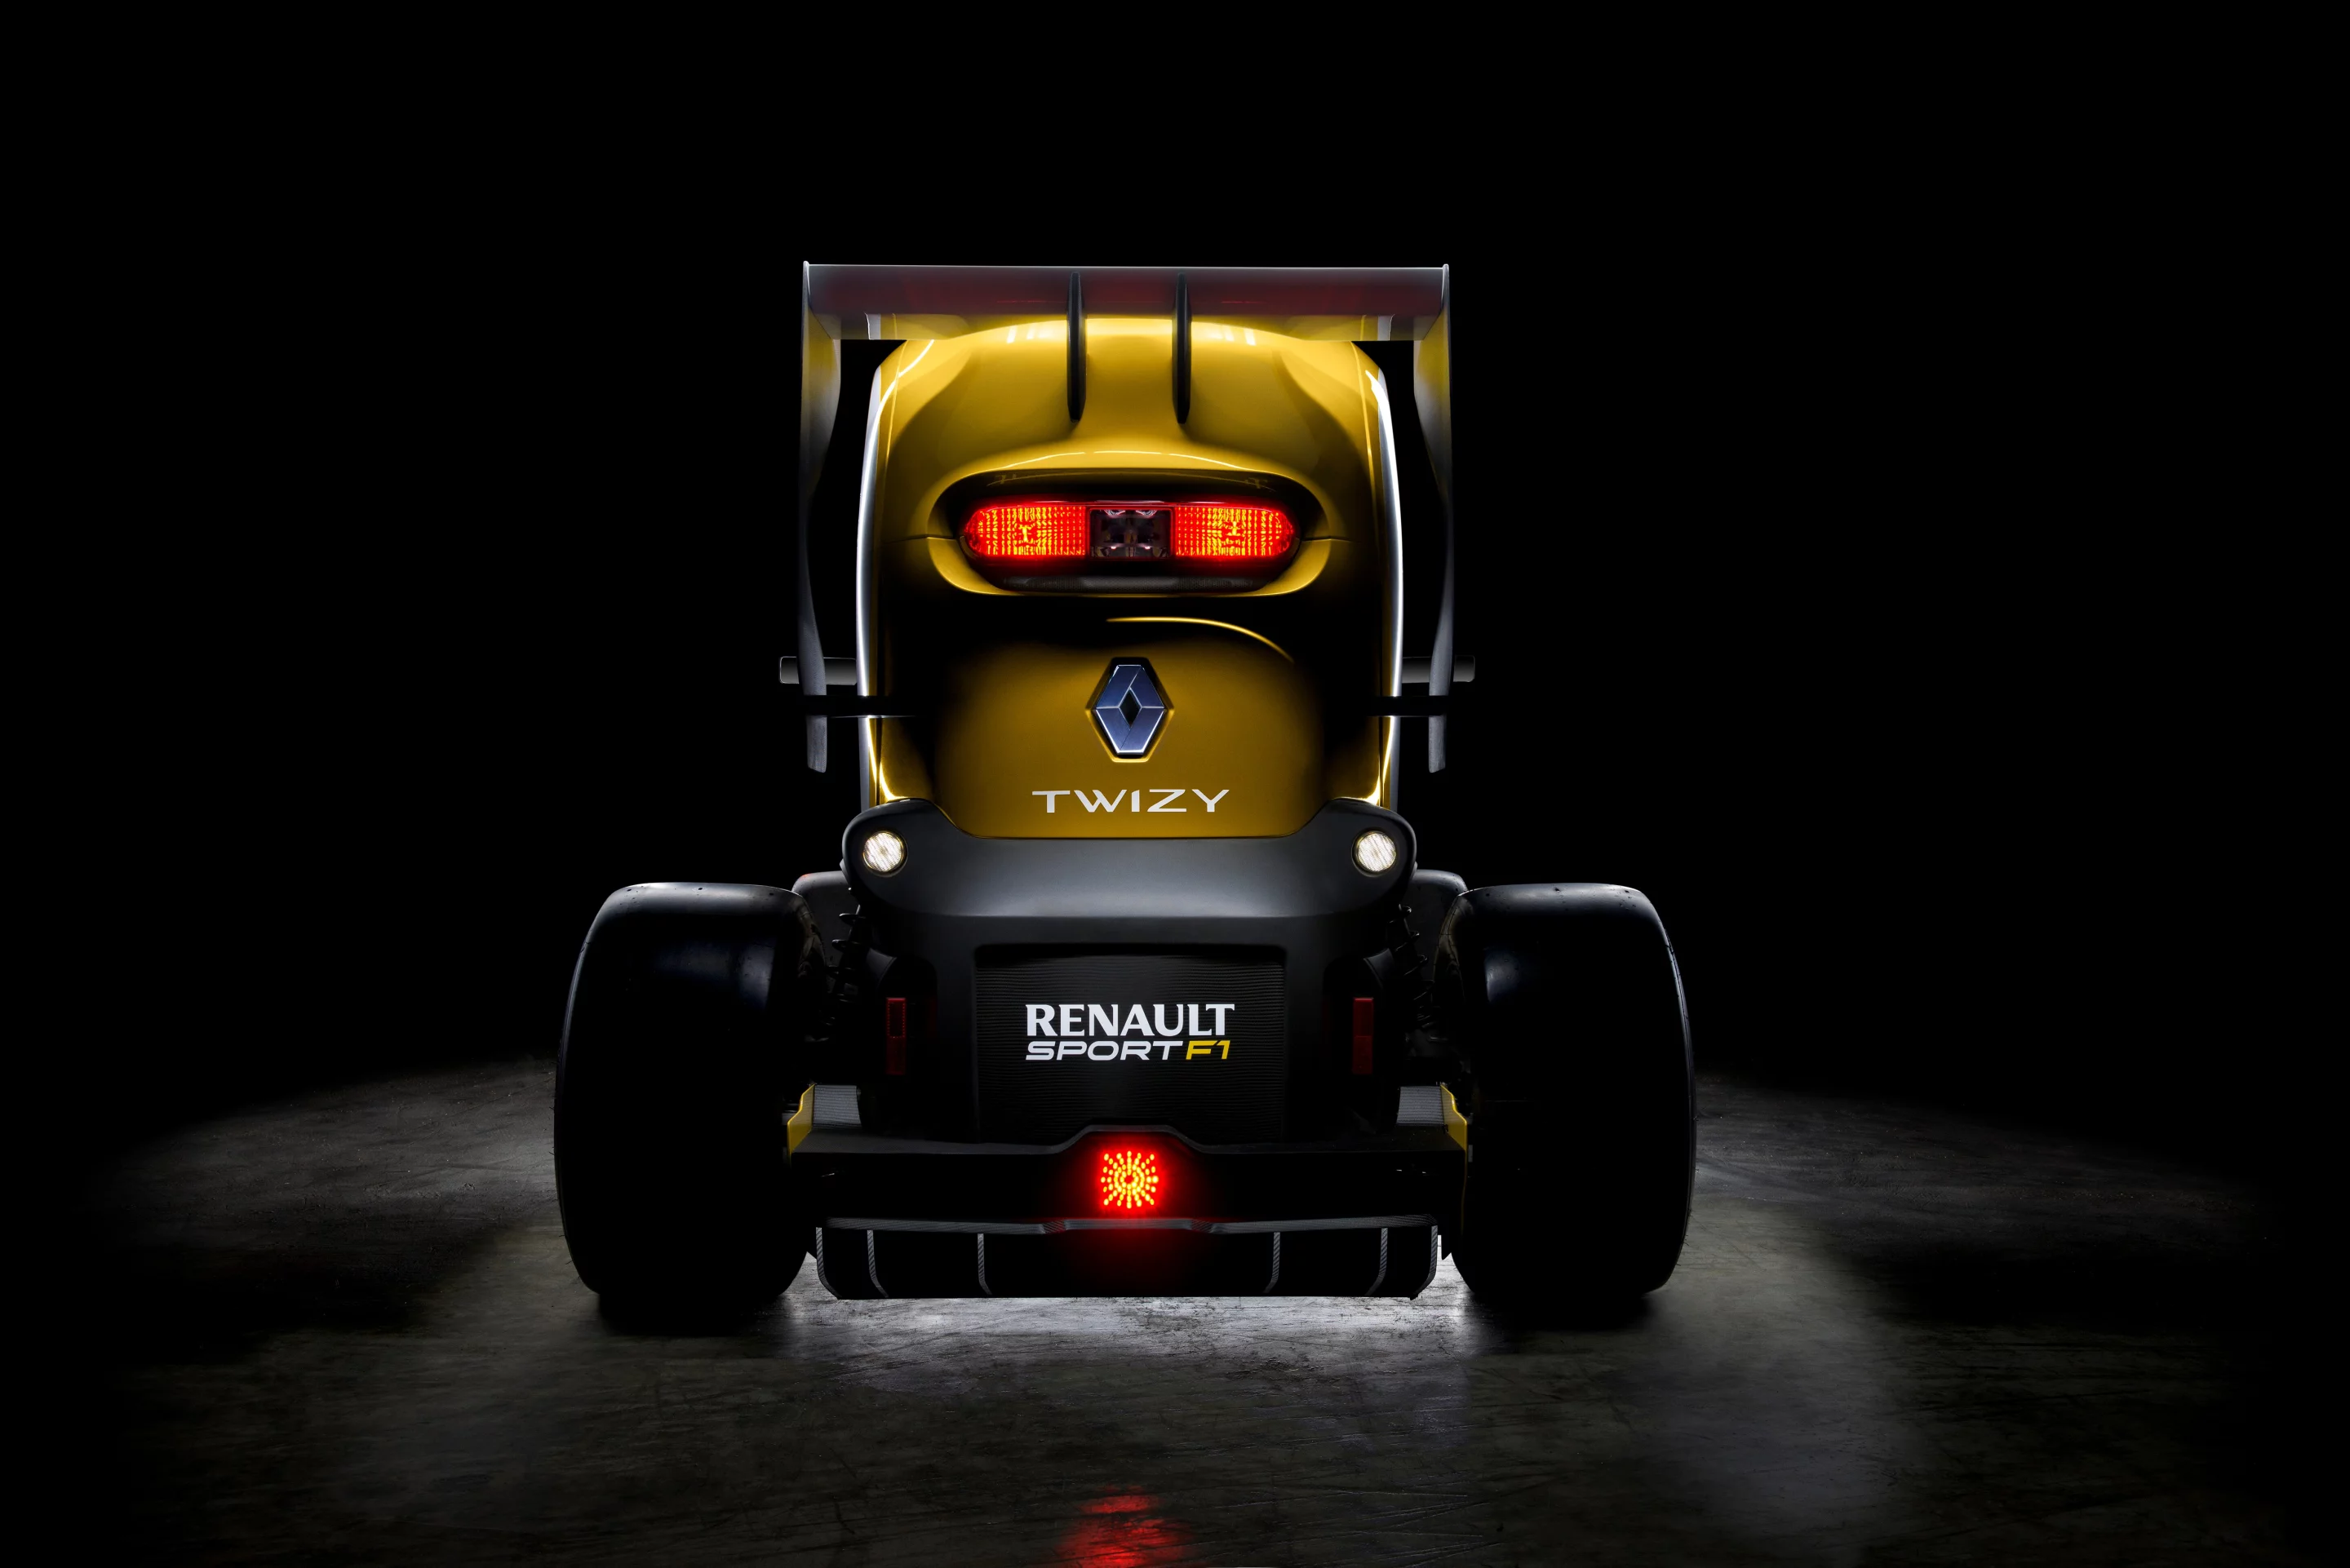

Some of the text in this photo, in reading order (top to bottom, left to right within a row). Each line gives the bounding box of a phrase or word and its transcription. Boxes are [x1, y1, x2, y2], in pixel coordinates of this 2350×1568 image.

[1032, 789, 1230, 813] TWIZY
[1025, 1003, 1235, 1036] RENAULT
[1026, 1040, 1230, 1061] SPORT F1
